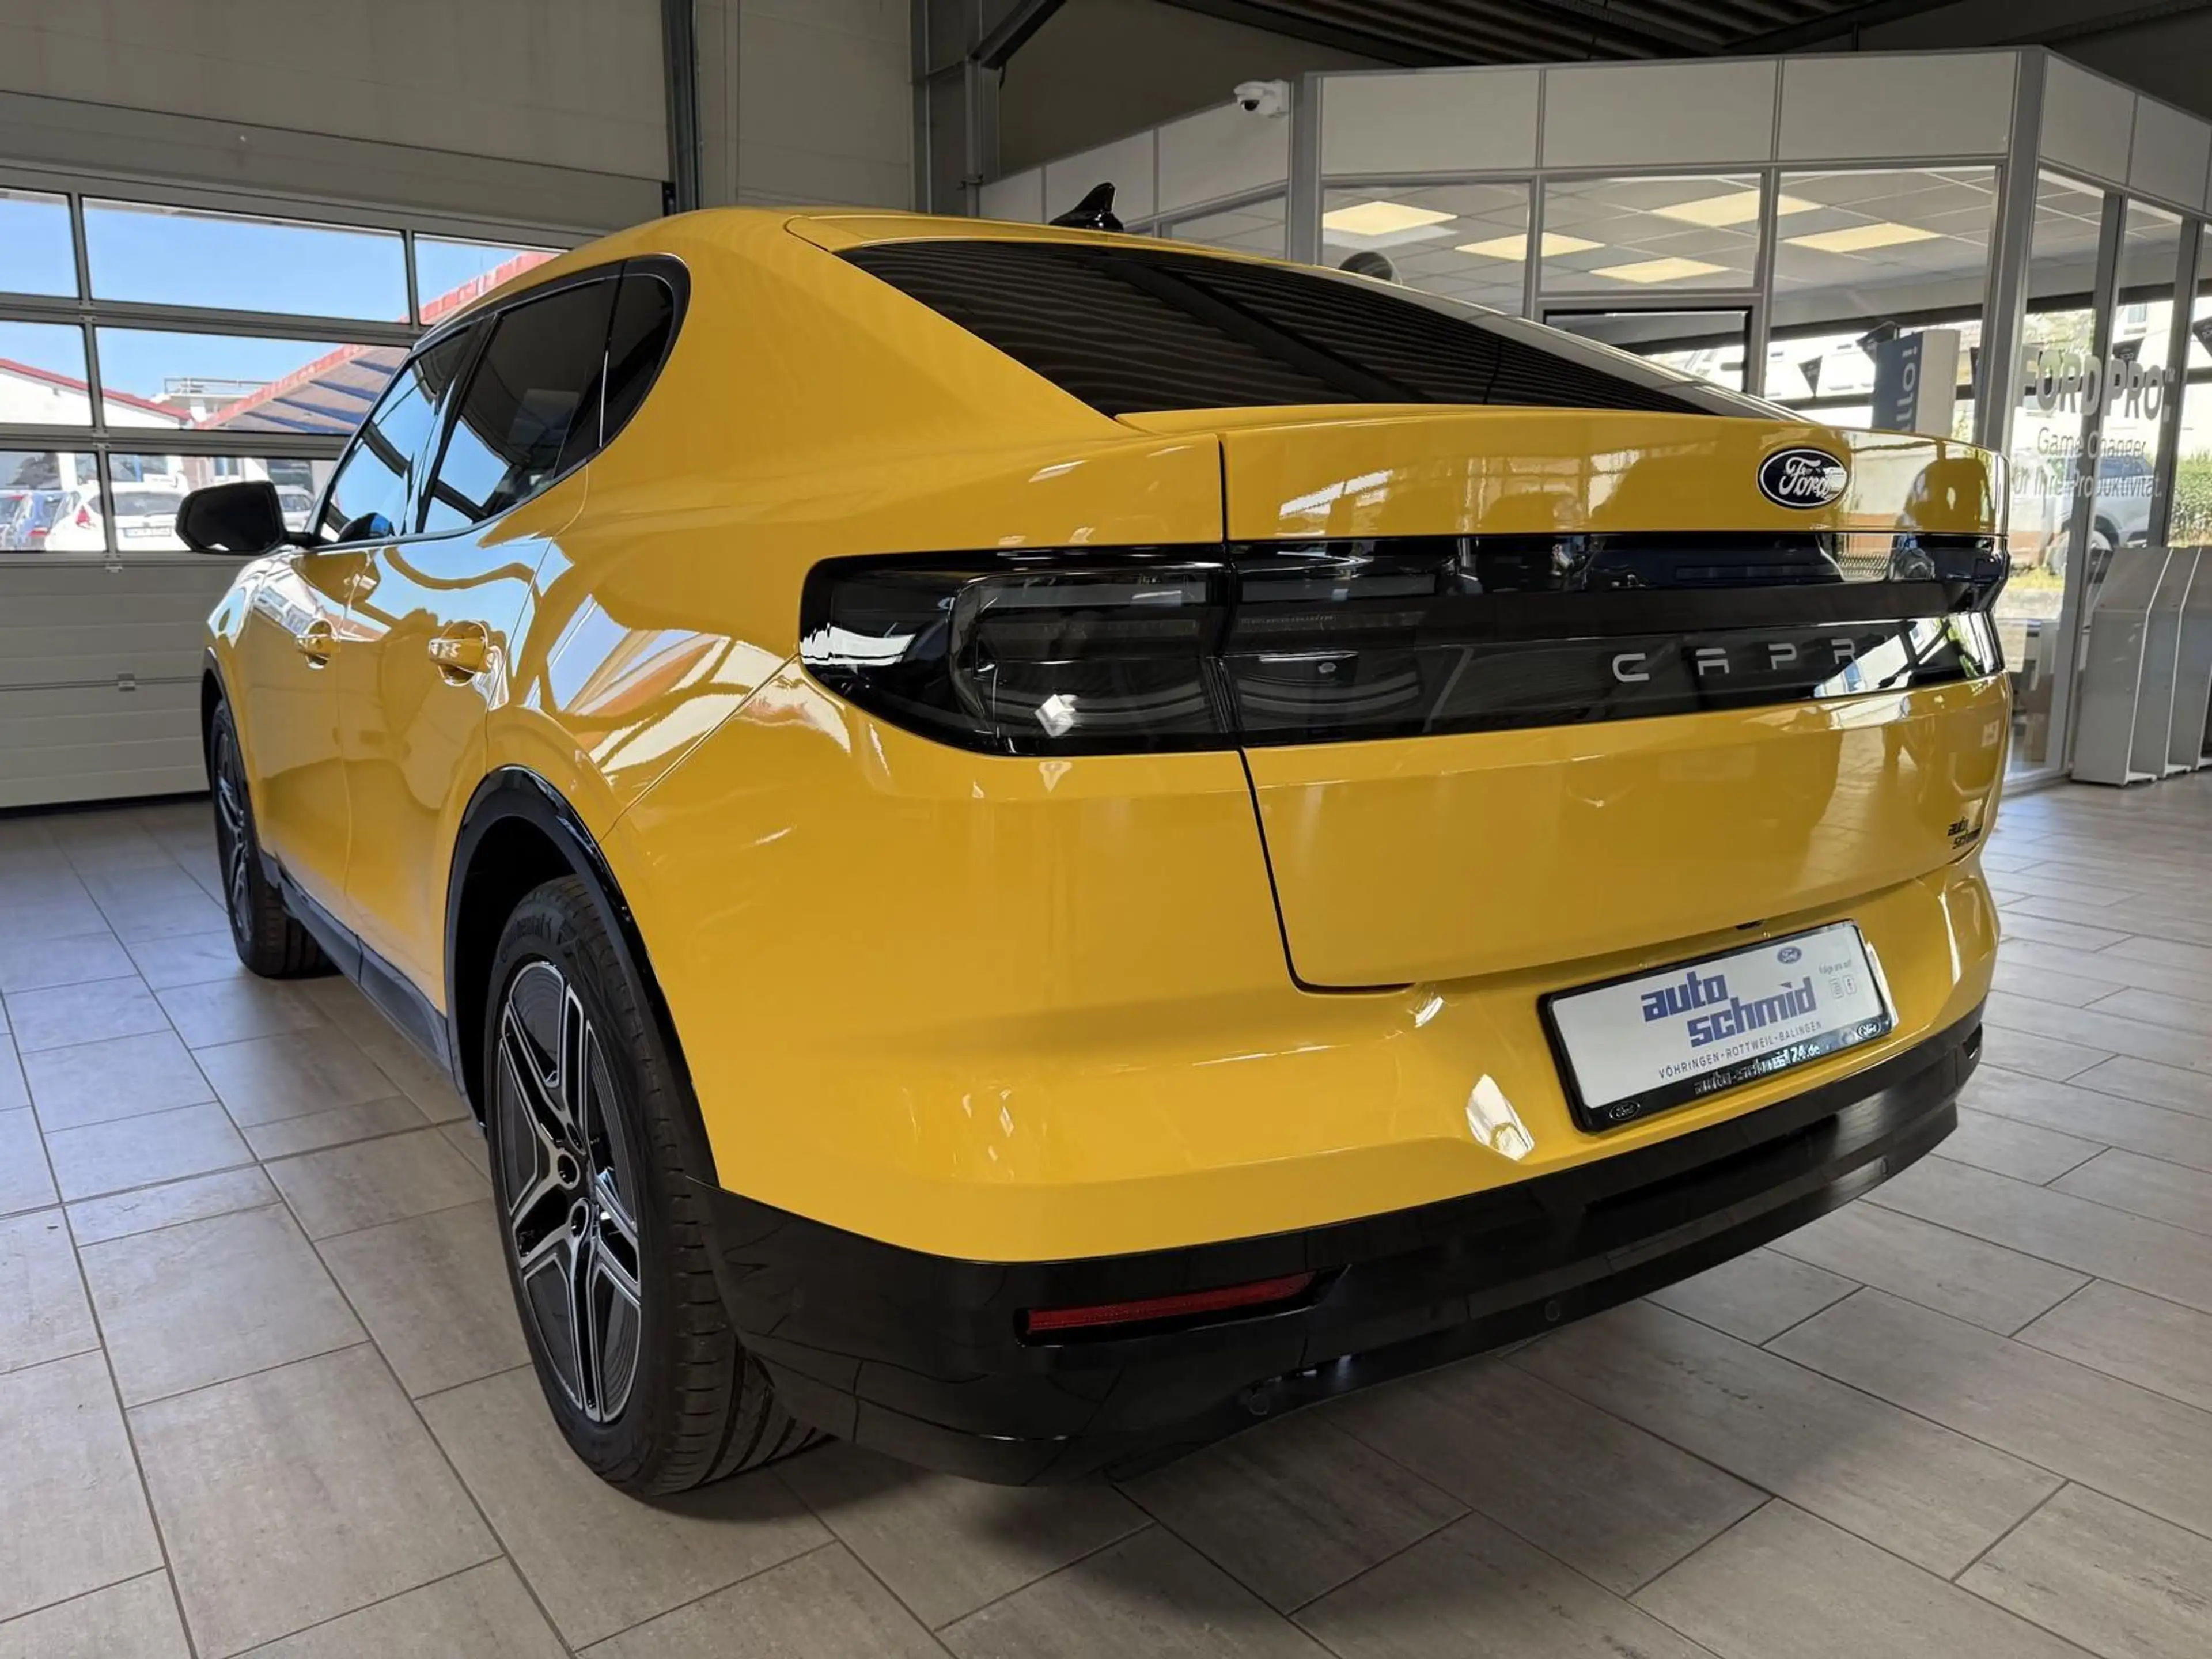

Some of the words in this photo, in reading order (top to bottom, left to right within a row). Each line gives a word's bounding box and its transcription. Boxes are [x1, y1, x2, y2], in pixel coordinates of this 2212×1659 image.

[1896, 346, 1918, 431] llo!
[2015, 346, 2103, 416] FORD
[2037, 427, 2084, 458] Game
[2088, 431, 2146, 465] Changer
[1778, 456, 1831, 500] Ford
[1613, 638, 1887, 682] CAPR
[1641, 971, 1728, 1022] auto
[1687, 976, 1817, 1047] schmid
